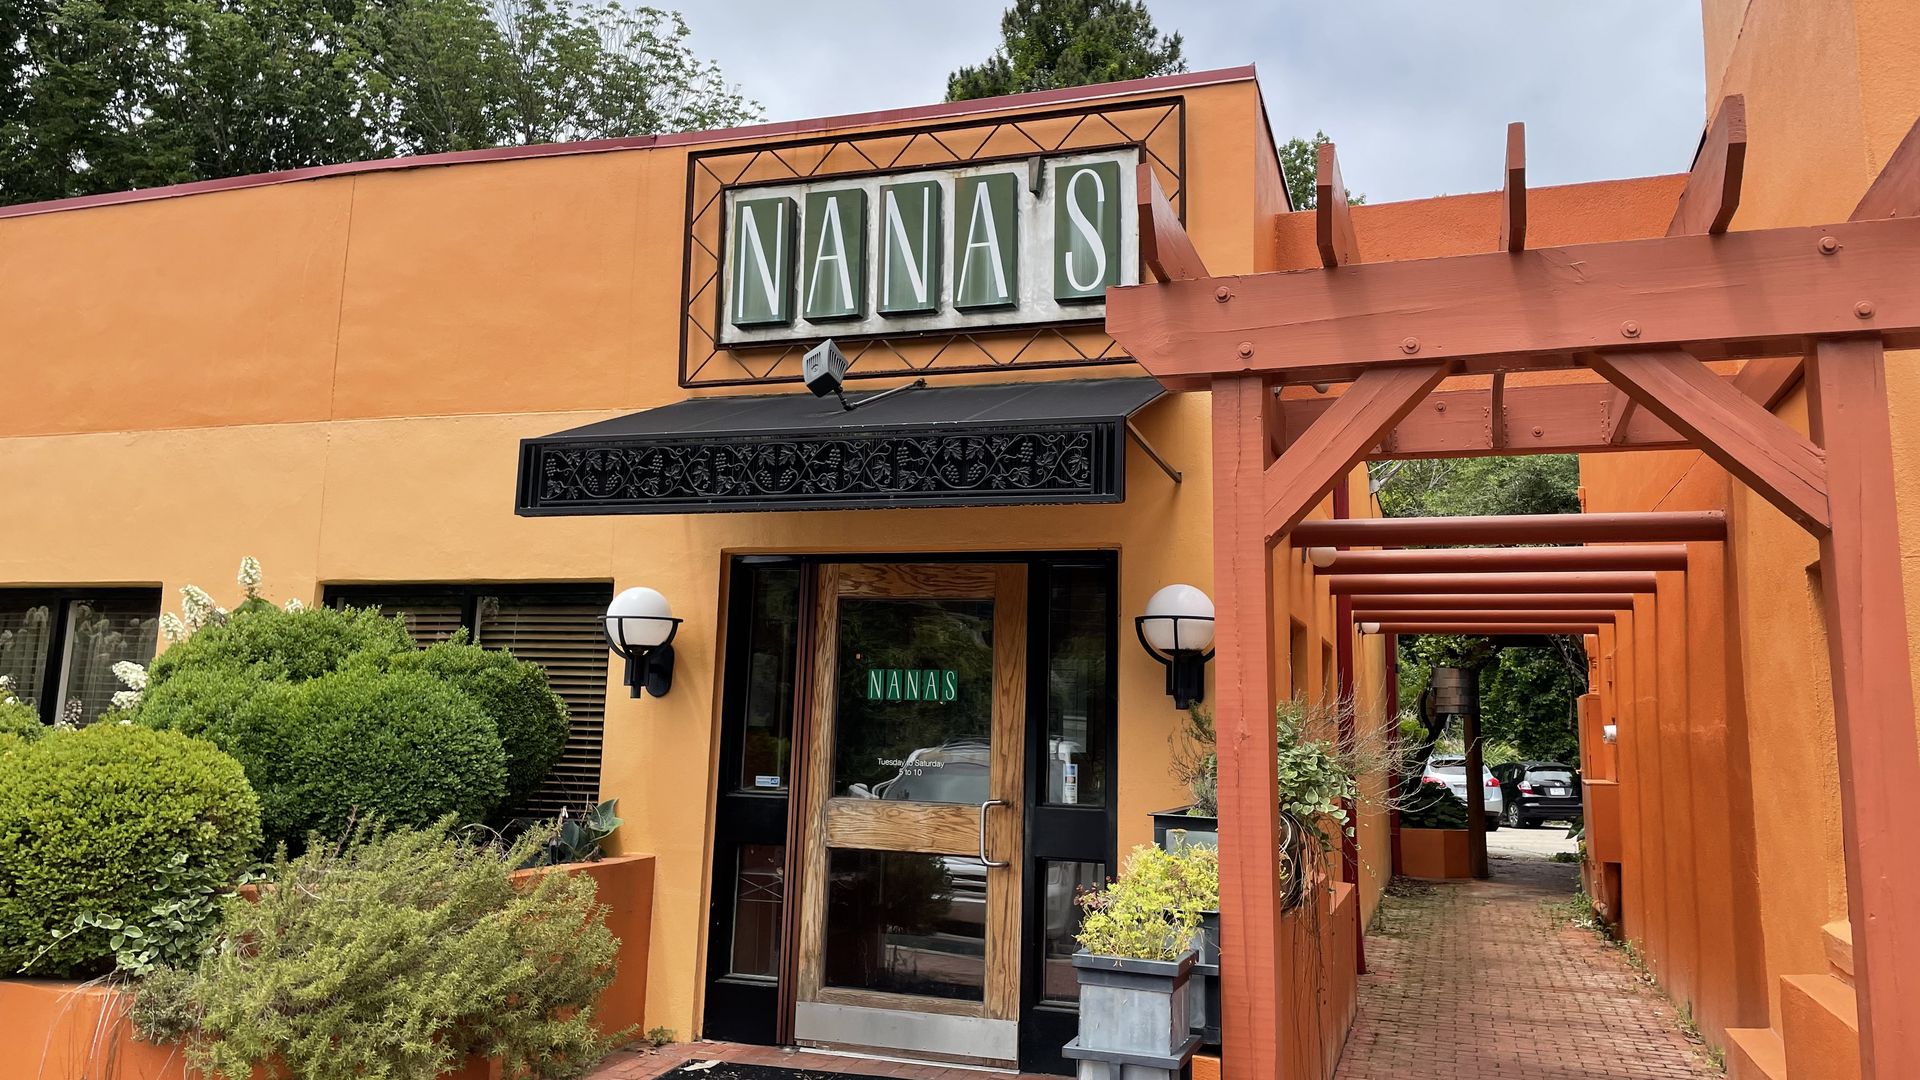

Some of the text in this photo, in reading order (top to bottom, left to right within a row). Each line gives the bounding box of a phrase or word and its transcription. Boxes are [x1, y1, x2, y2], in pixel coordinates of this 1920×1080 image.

[738, 157, 1107, 318] NANA'S
[870, 670, 955, 700] NANAS
[877, 757, 945, 768] Tuesday to Saturday
